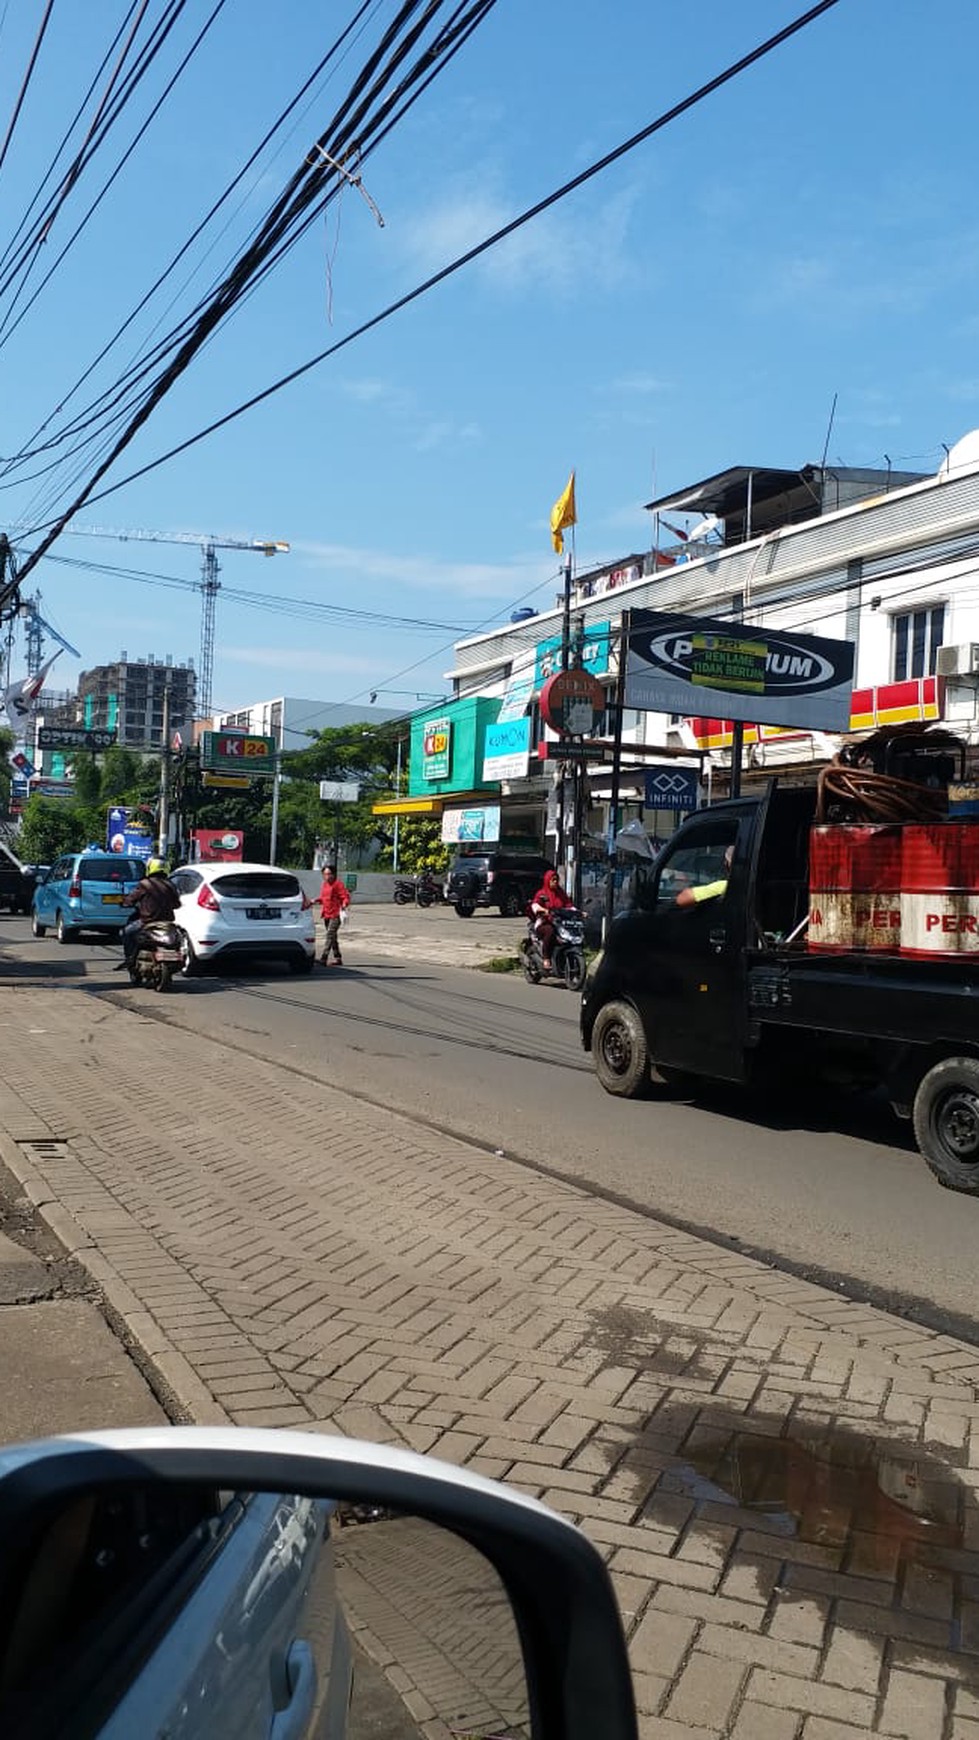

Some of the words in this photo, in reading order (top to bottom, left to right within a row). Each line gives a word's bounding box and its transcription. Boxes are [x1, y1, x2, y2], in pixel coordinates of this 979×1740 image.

[704, 650, 755, 667] REKLAME
[692, 661, 723, 675] TIDAK
[650, 793, 692, 805] INFINITI
